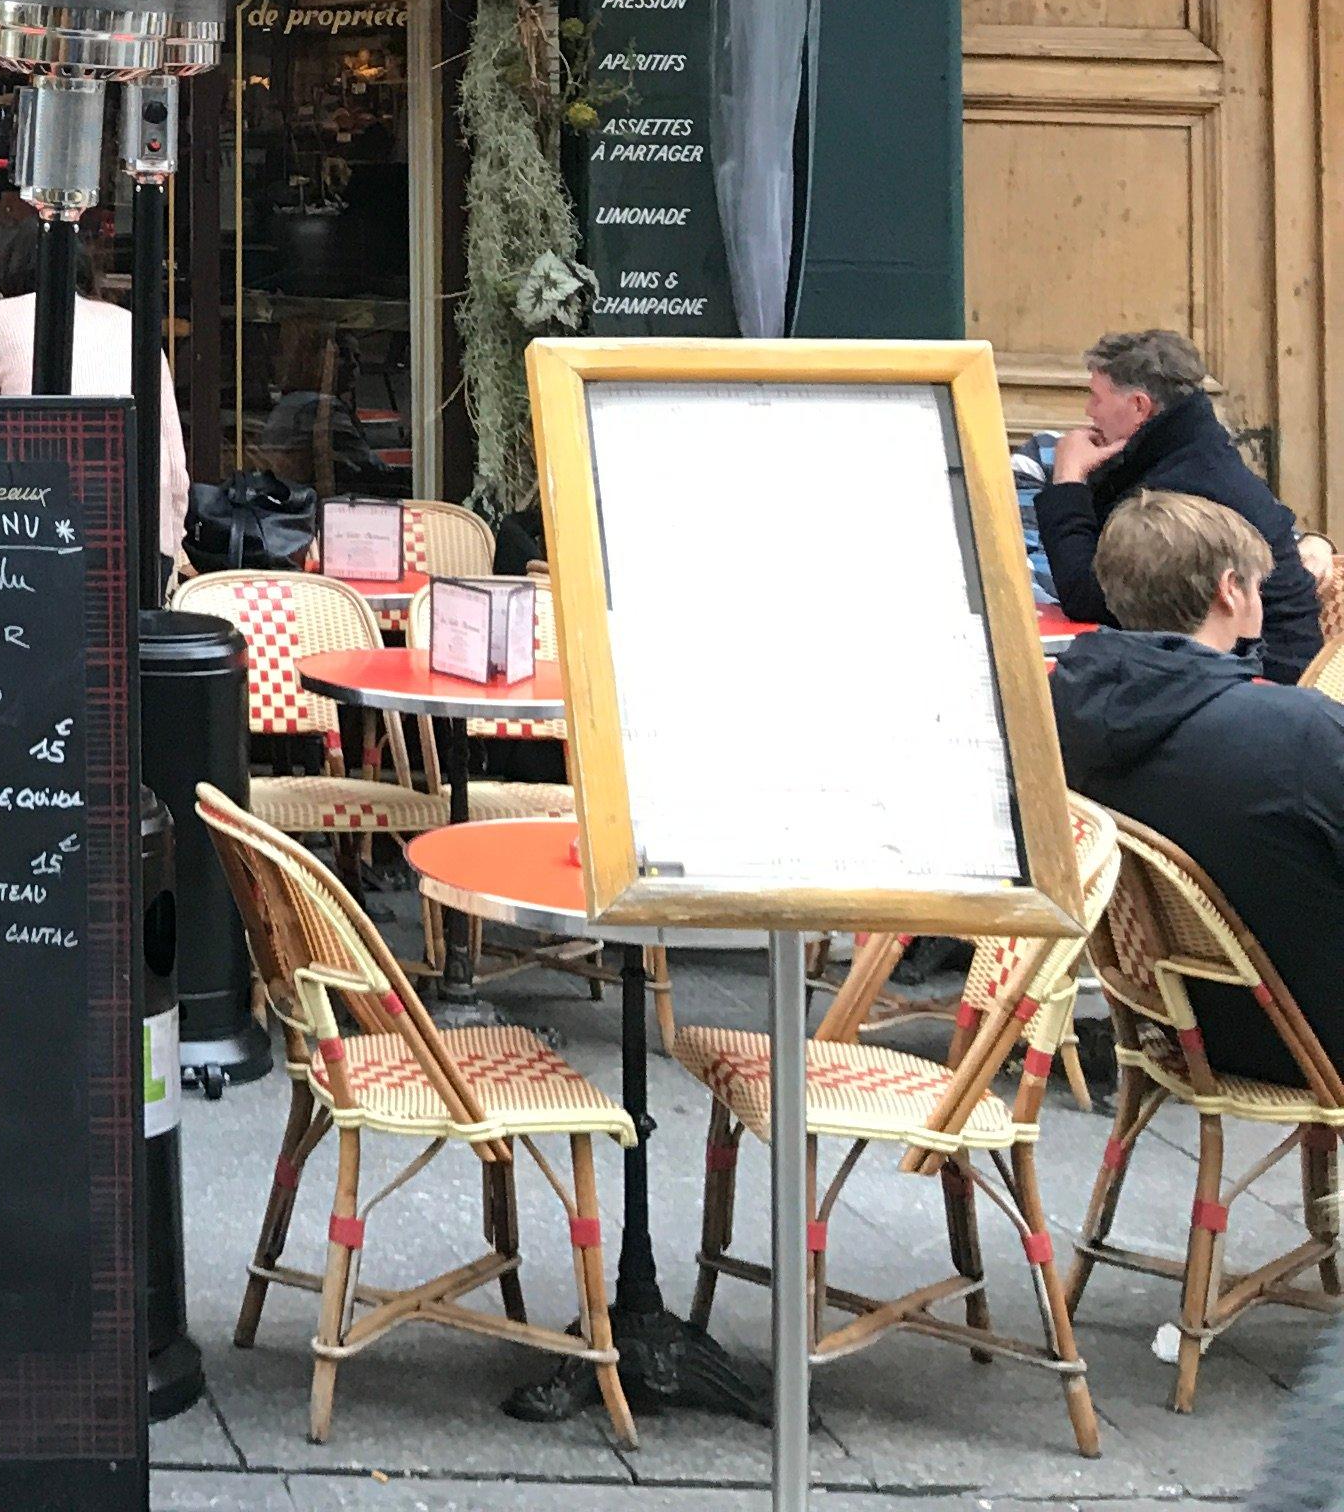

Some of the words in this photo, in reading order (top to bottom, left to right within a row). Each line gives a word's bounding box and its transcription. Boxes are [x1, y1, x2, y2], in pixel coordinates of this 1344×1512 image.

[248, 0, 278, 26] de
[602, 119, 693, 136] ASSIETTES
[590, 141, 606, 161] À
[609, 144, 704, 162] PARTAGER
[595, 206, 692, 225] LIMONADE
[620, 271, 661, 289] VINS
[664, 272, 680, 289] &
[592, 297, 708, 315] CHAMPAGNE
